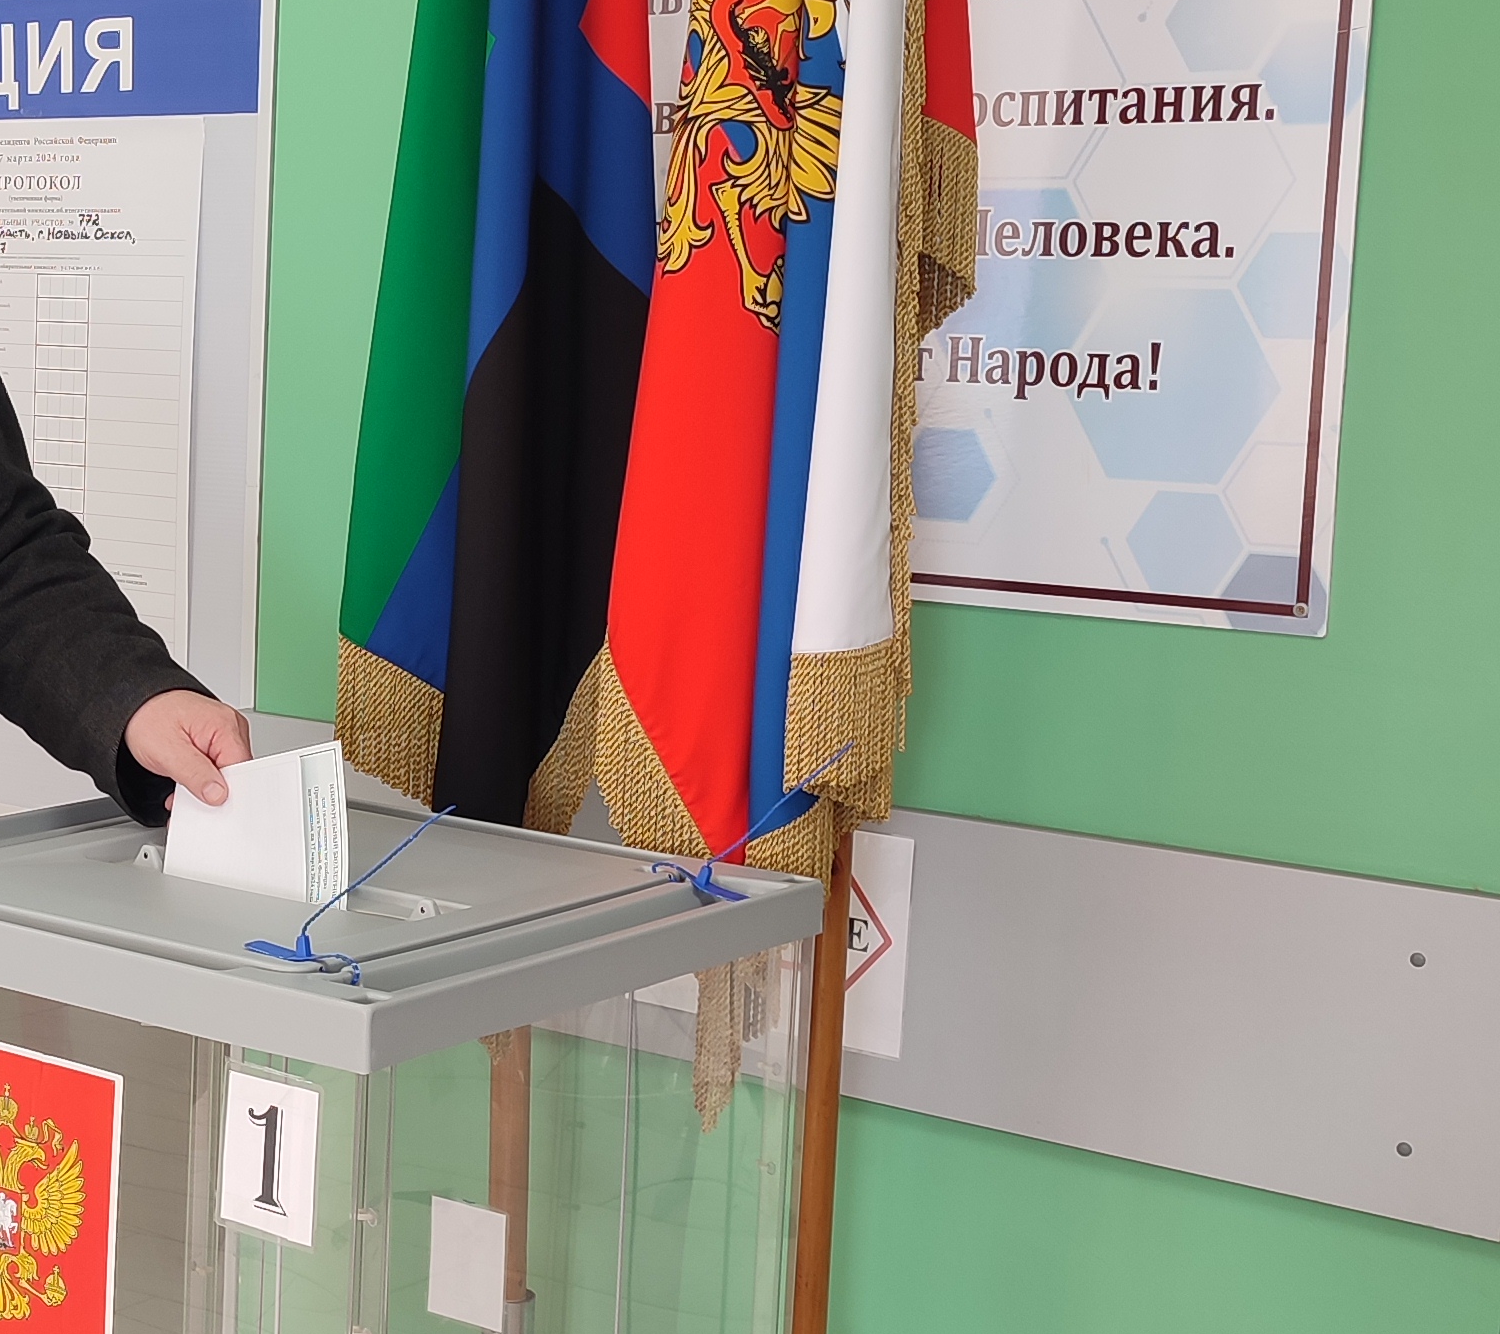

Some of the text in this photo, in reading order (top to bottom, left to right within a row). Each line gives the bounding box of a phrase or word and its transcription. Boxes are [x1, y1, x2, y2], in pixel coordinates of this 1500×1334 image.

[973, 81, 1276, 128] спитания.
[6, 154, 33, 165] марта
[36, 153, 57, 163] 2024
[59, 153, 81, 163] года
[33, 136, 75, 146] Российской
[78, 213, 100, 227] 772
[976, 208, 1238, 259] еловека.
[946, 336, 1162, 400] Народа!
[249, 1105, 286, 1216] 1
